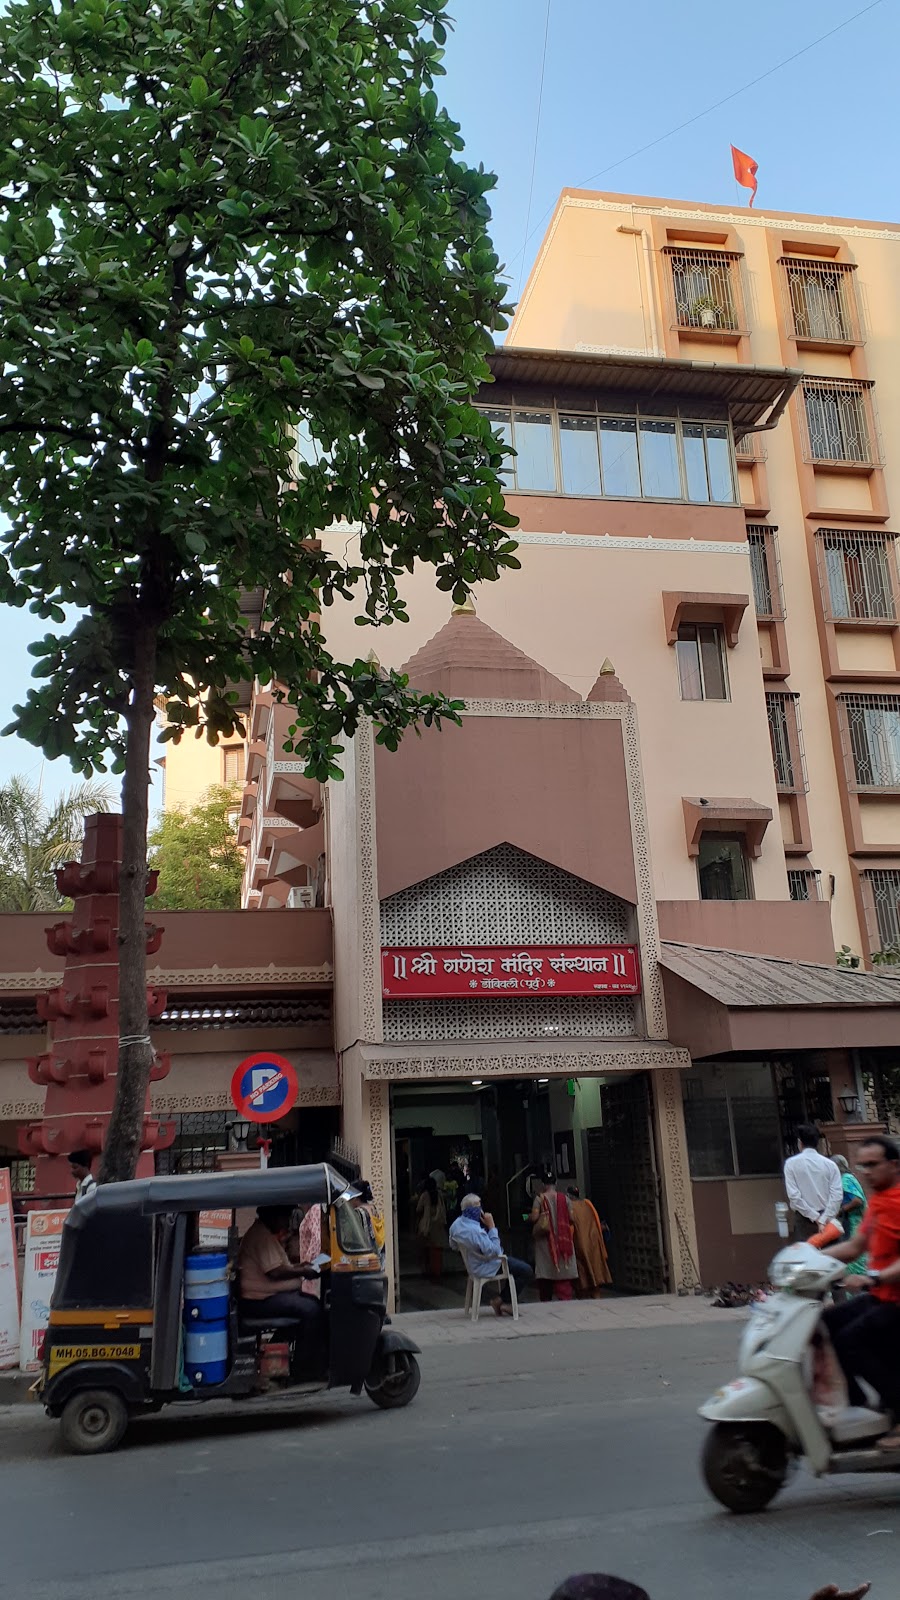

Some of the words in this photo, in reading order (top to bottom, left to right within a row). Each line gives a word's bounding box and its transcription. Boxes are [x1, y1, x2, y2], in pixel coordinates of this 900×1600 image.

[411, 952, 438, 975] श्री
[442, 951, 496, 975] गणेश
[500, 952, 543, 976] मंदिर
[547, 953, 609, 973] संस्थान
[249, 1090, 260, 1100] NO
[258, 1072, 283, 1092] PARKING
